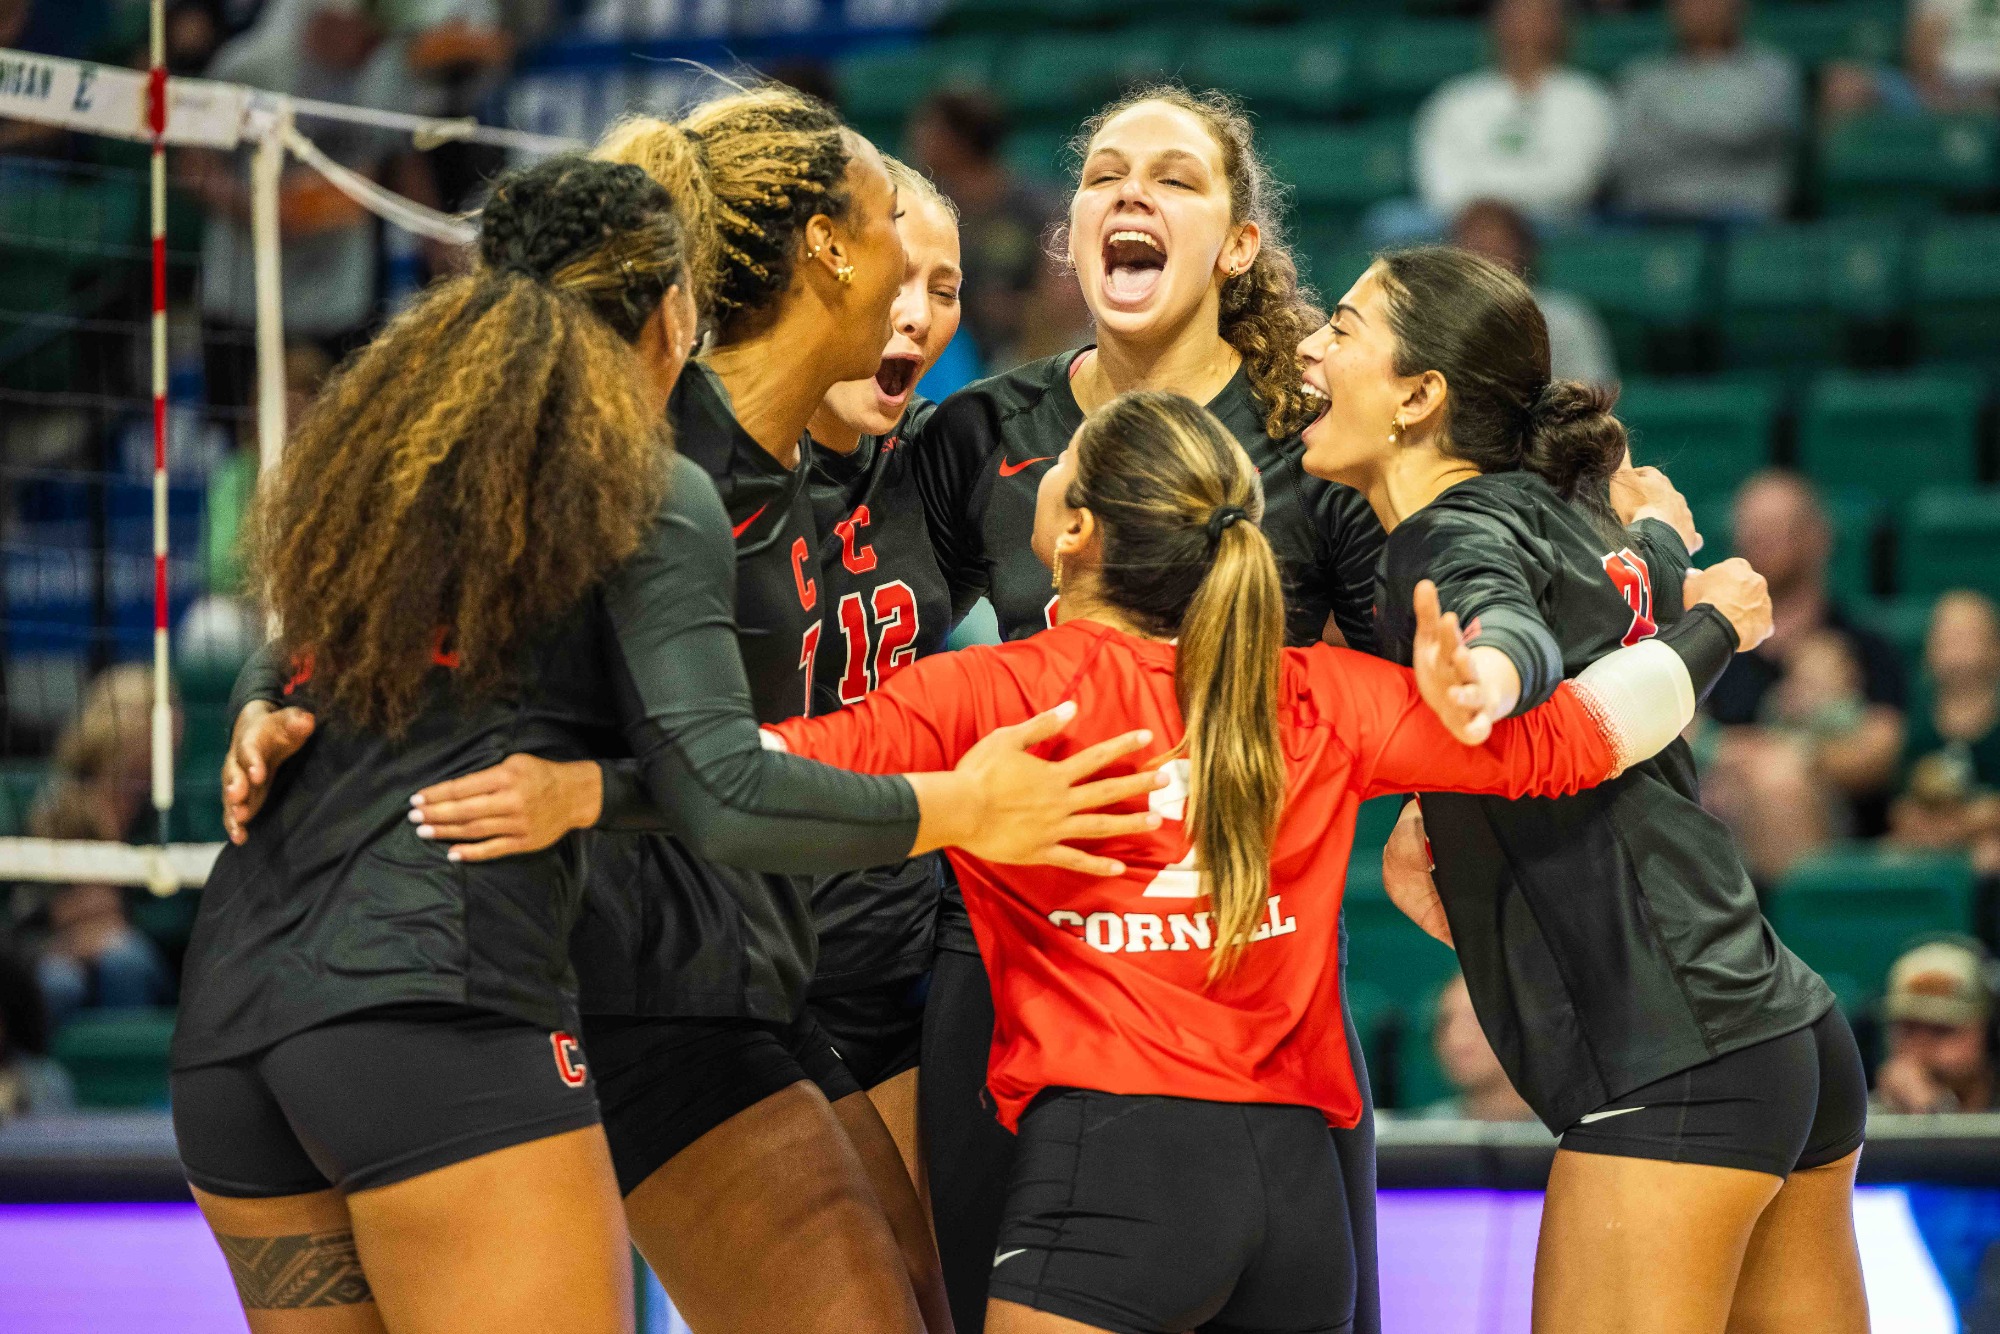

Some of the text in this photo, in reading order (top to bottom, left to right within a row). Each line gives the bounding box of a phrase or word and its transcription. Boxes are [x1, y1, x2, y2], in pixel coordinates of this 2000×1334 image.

[791, 536, 817, 612] C
[833, 505, 877, 574] C
[837, 579, 920, 705] 12
[1048, 894, 1297, 953] CORNL
[550, 1031, 587, 1088] C
